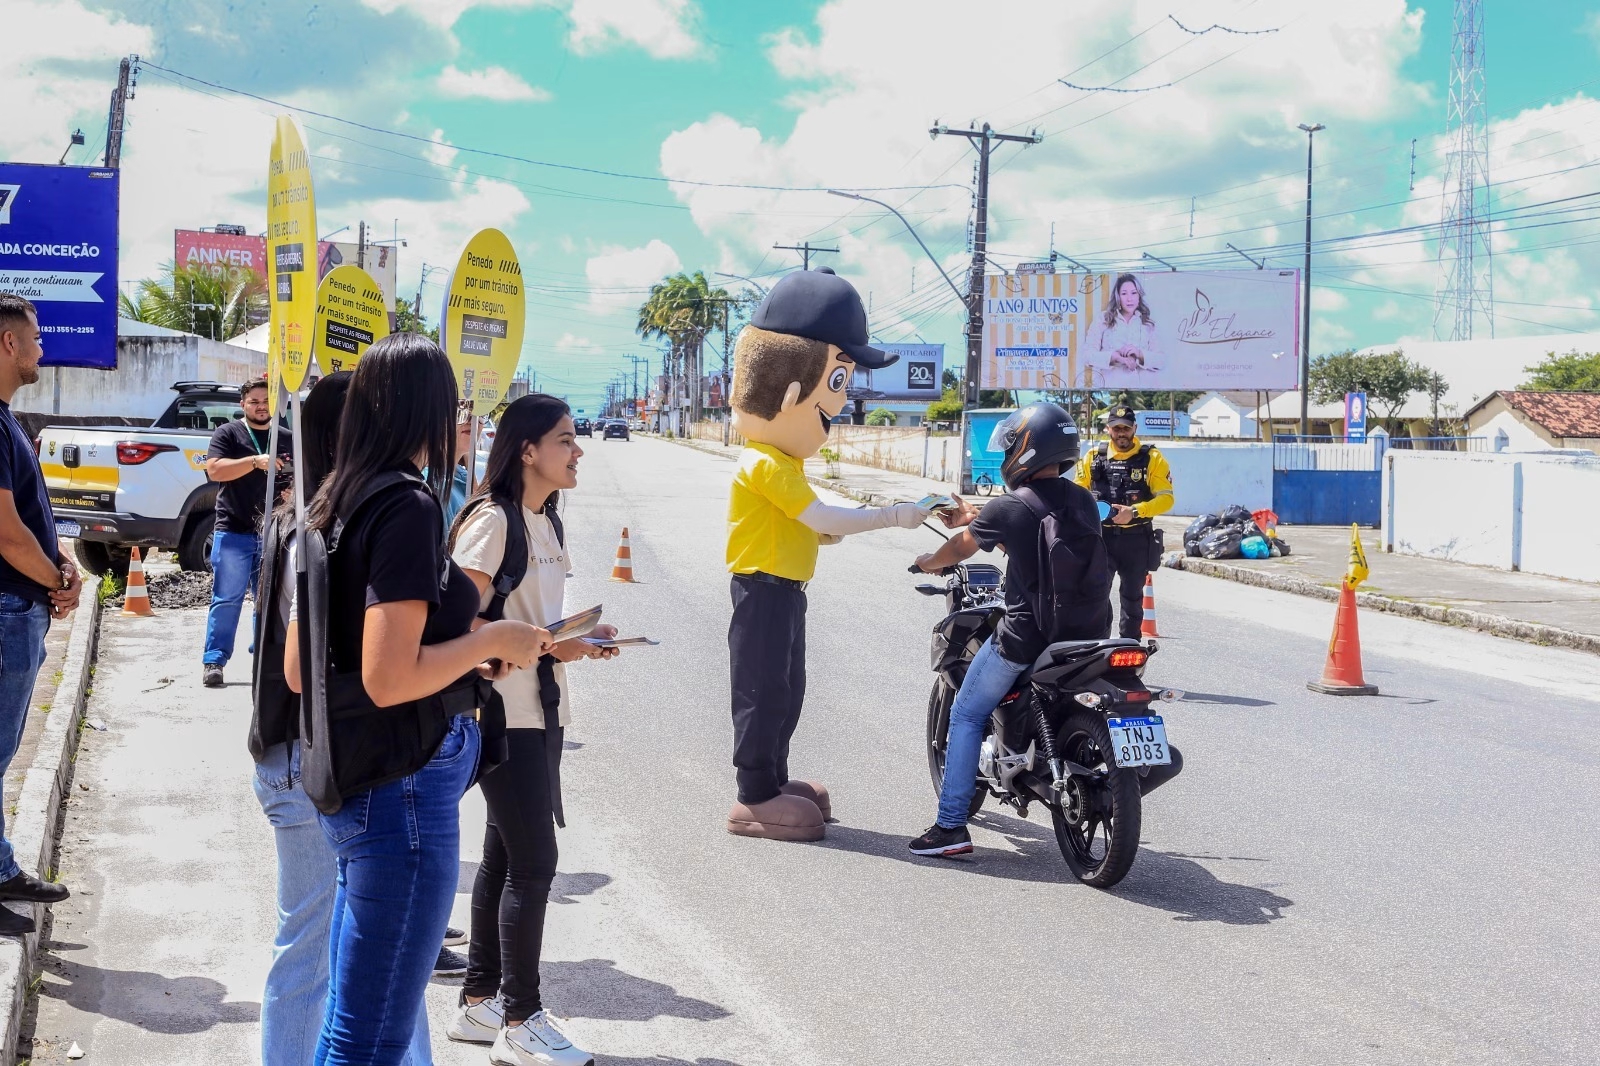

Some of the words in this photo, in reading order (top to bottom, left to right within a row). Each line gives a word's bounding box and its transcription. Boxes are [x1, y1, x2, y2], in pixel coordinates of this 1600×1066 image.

[23, 242, 100, 258] CONCEIÇÃO
[186, 246, 252, 267] ANIVER
[467, 252, 493, 269] Penedo
[13, 276, 30, 288] que
[32, 275, 83, 286] continuam
[330, 278, 356, 294] Penedo
[465, 277, 477, 290] por
[480, 279, 490, 290] um
[492, 279, 518, 295] trânsito
[16, 286, 44, 296] vidas.
[328, 294, 341, 303] por
[342, 298, 354, 308] um
[356, 301, 382, 317] trânsito
[464, 296, 480, 310] mais
[482, 300, 506, 315] seguro.
[996, 299, 1024, 314] ANO
[1028, 298, 1078, 314] JUNTOS
[328, 308, 344, 320] mais
[346, 314, 371, 328] seguro.
[465, 320, 483, 330] RESPEITE
[329, 324, 349, 336] RESPEITE
[1177, 318, 1201, 340] Isa
[1209, 313, 1276, 350] Elegance
[328, 338, 341, 347] SALVE
[463, 340, 476, 350] SALVE
[1122, 726, 1155, 744] TNJ
[1122, 744, 1164, 761] 8D83
